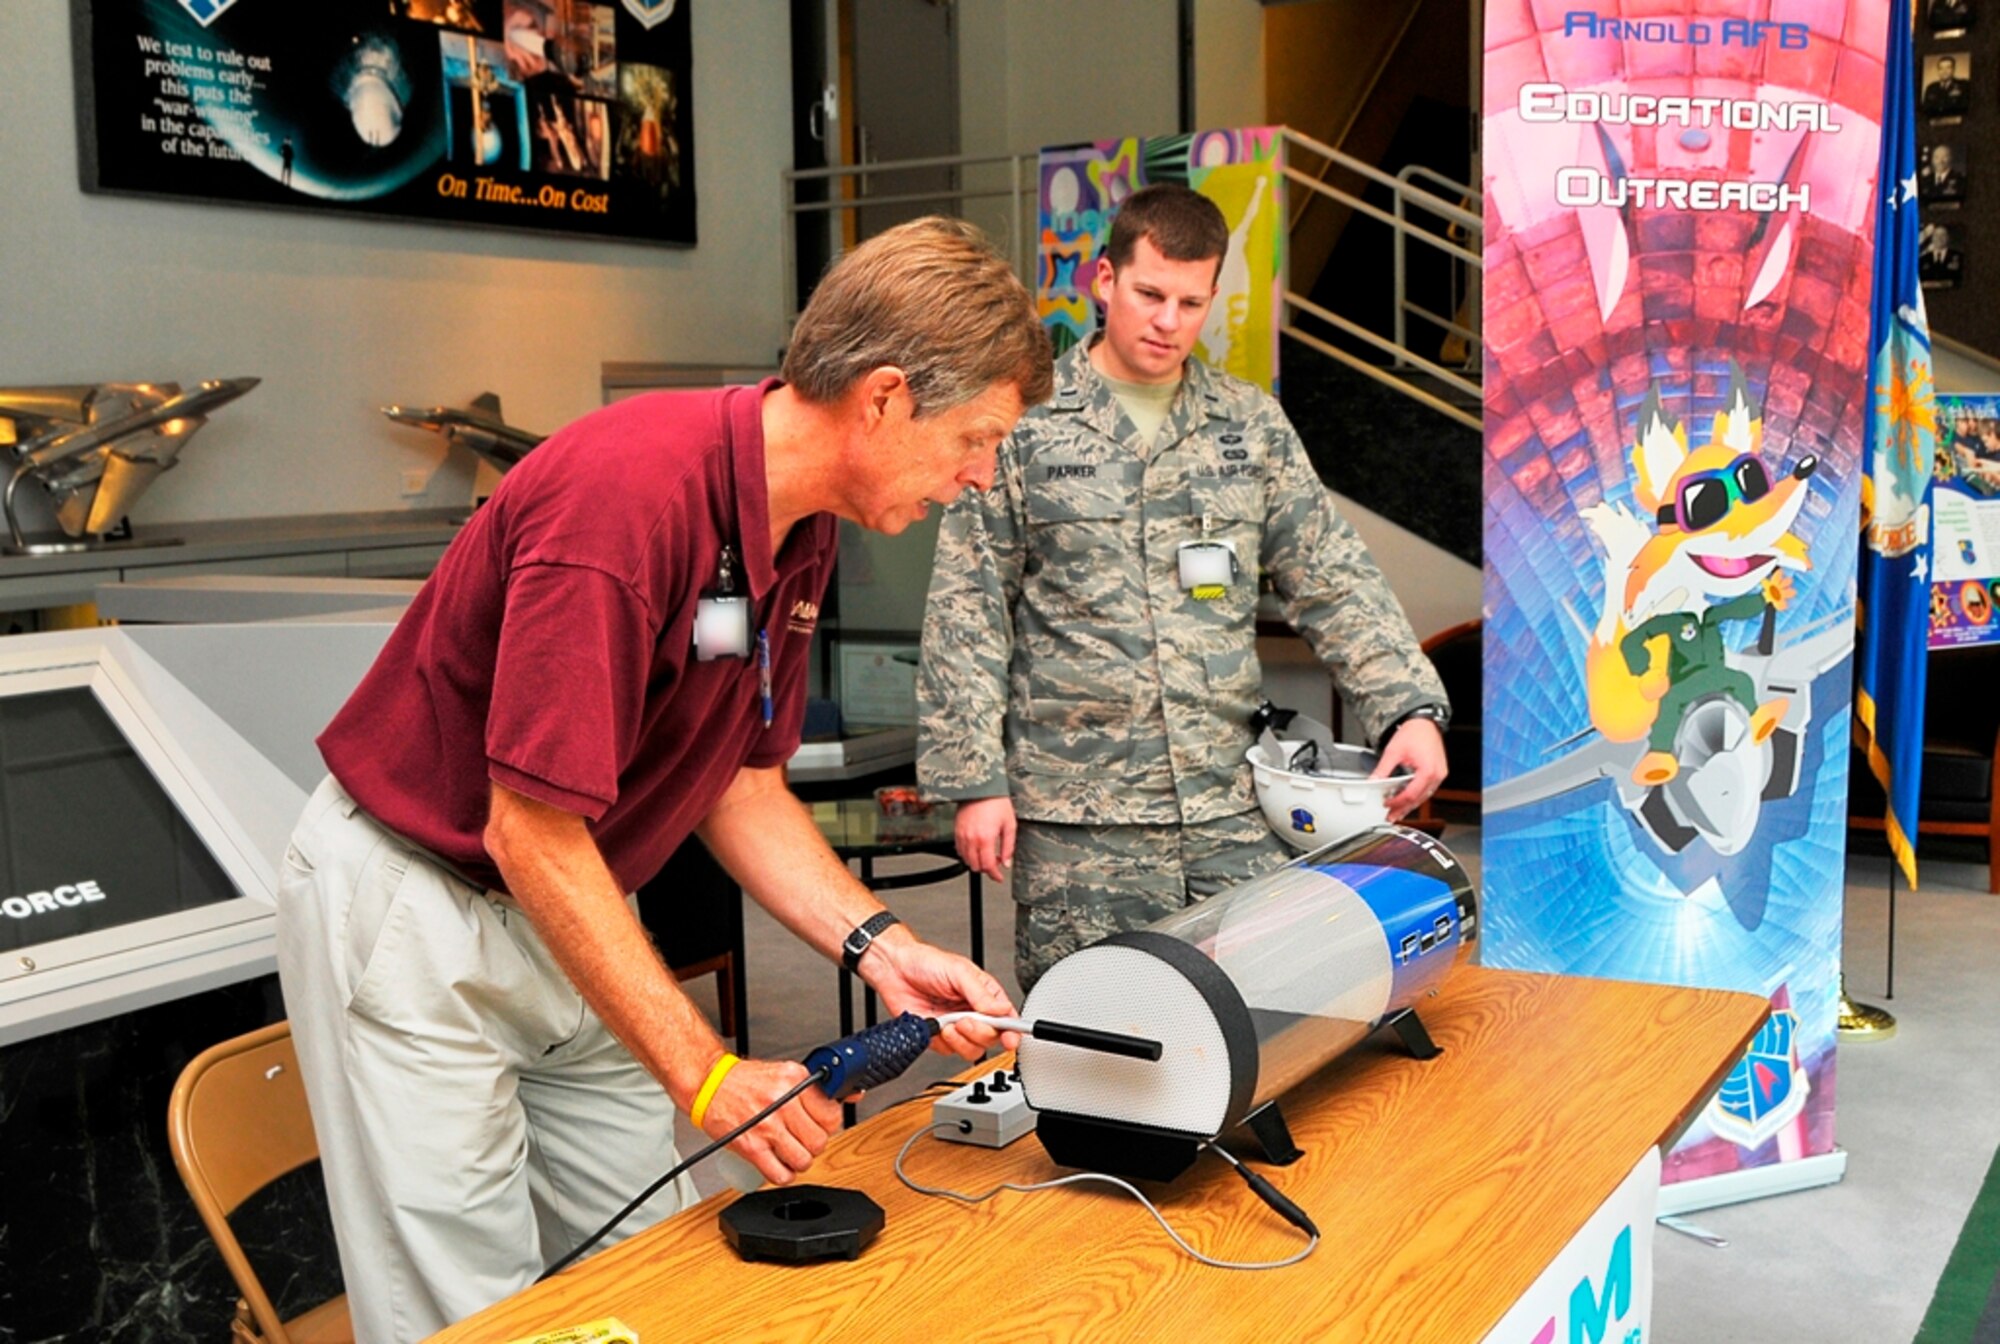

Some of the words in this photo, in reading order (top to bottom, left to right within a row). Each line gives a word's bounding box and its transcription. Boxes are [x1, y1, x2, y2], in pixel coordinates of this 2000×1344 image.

[1721, 19, 1810, 50] AFB
[136, 34, 161, 54] We
[165, 40, 193, 58] test
[197, 46, 213, 61] to
[216, 49, 244, 67] rule
[248, 55, 272, 71] out
[145, 58, 214, 81] problems
[161, 78, 189, 97] this
[193, 84, 225, 103] puts
[229, 87, 252, 105] the
[1518, 82, 1841, 132] EDUCATIONAL
[141, 113, 156, 132] in
[160, 117, 184, 135] the
[161, 136, 178, 153] of
[181, 139, 205, 157] the
[208, 141, 252, 161] futur
[437, 173, 468, 197] On
[570, 189, 609, 213] Cost
[1556, 166, 1810, 213] OUTREACH
[1047, 464, 1096, 480] PARKER
[0, 880, 106, 919] ORCE
